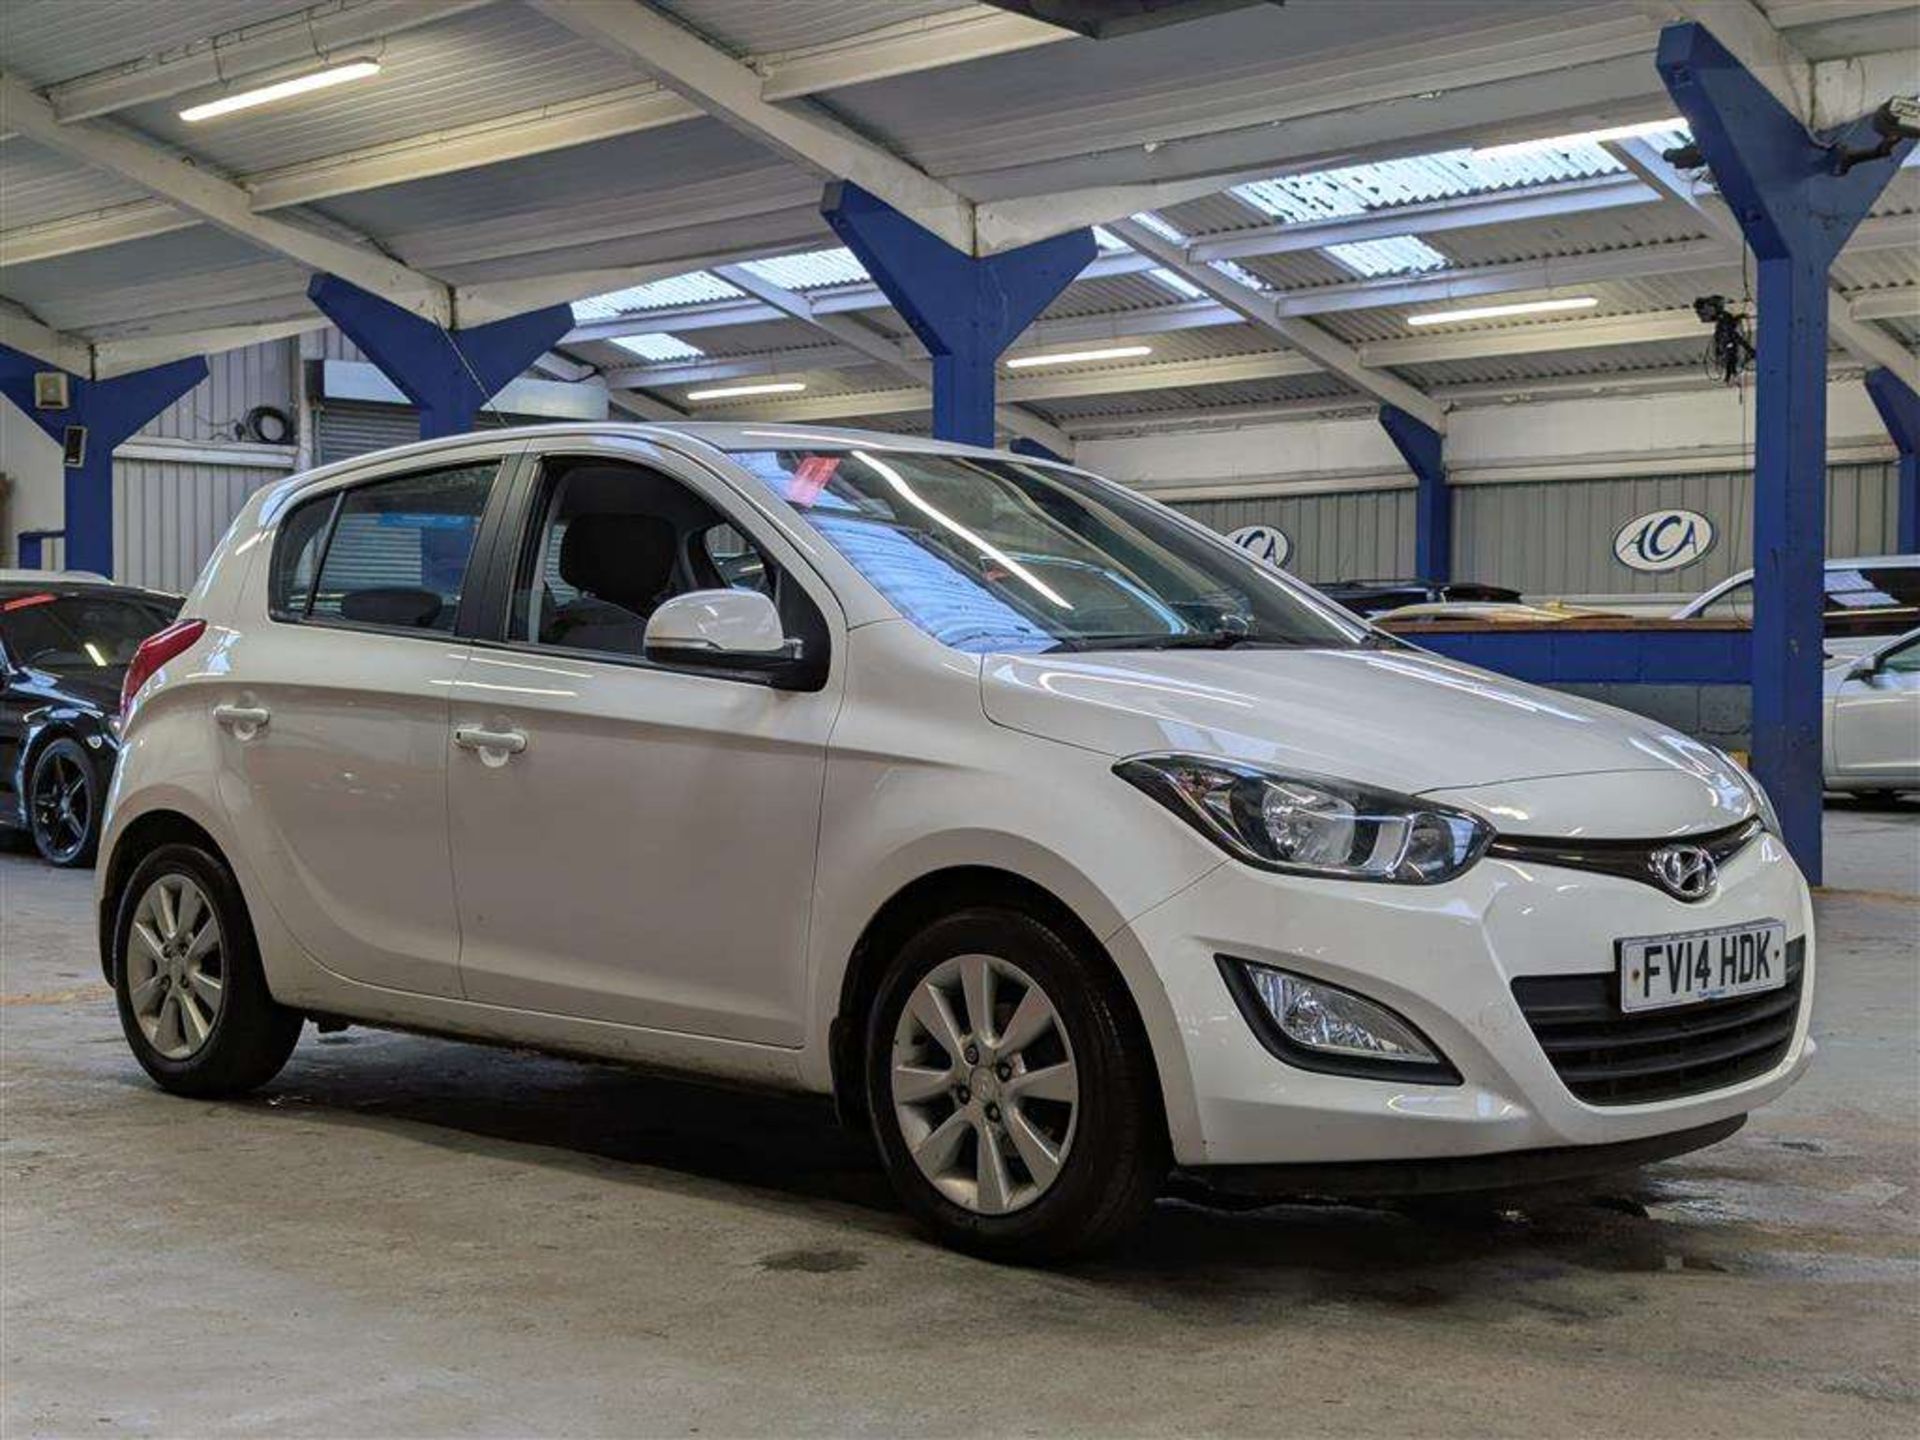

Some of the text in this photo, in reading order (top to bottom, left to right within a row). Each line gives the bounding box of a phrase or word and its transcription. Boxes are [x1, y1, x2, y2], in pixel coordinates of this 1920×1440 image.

[1620, 515, 1697, 562] ACA
[1644, 930, 1771, 998] FV14 HDK
